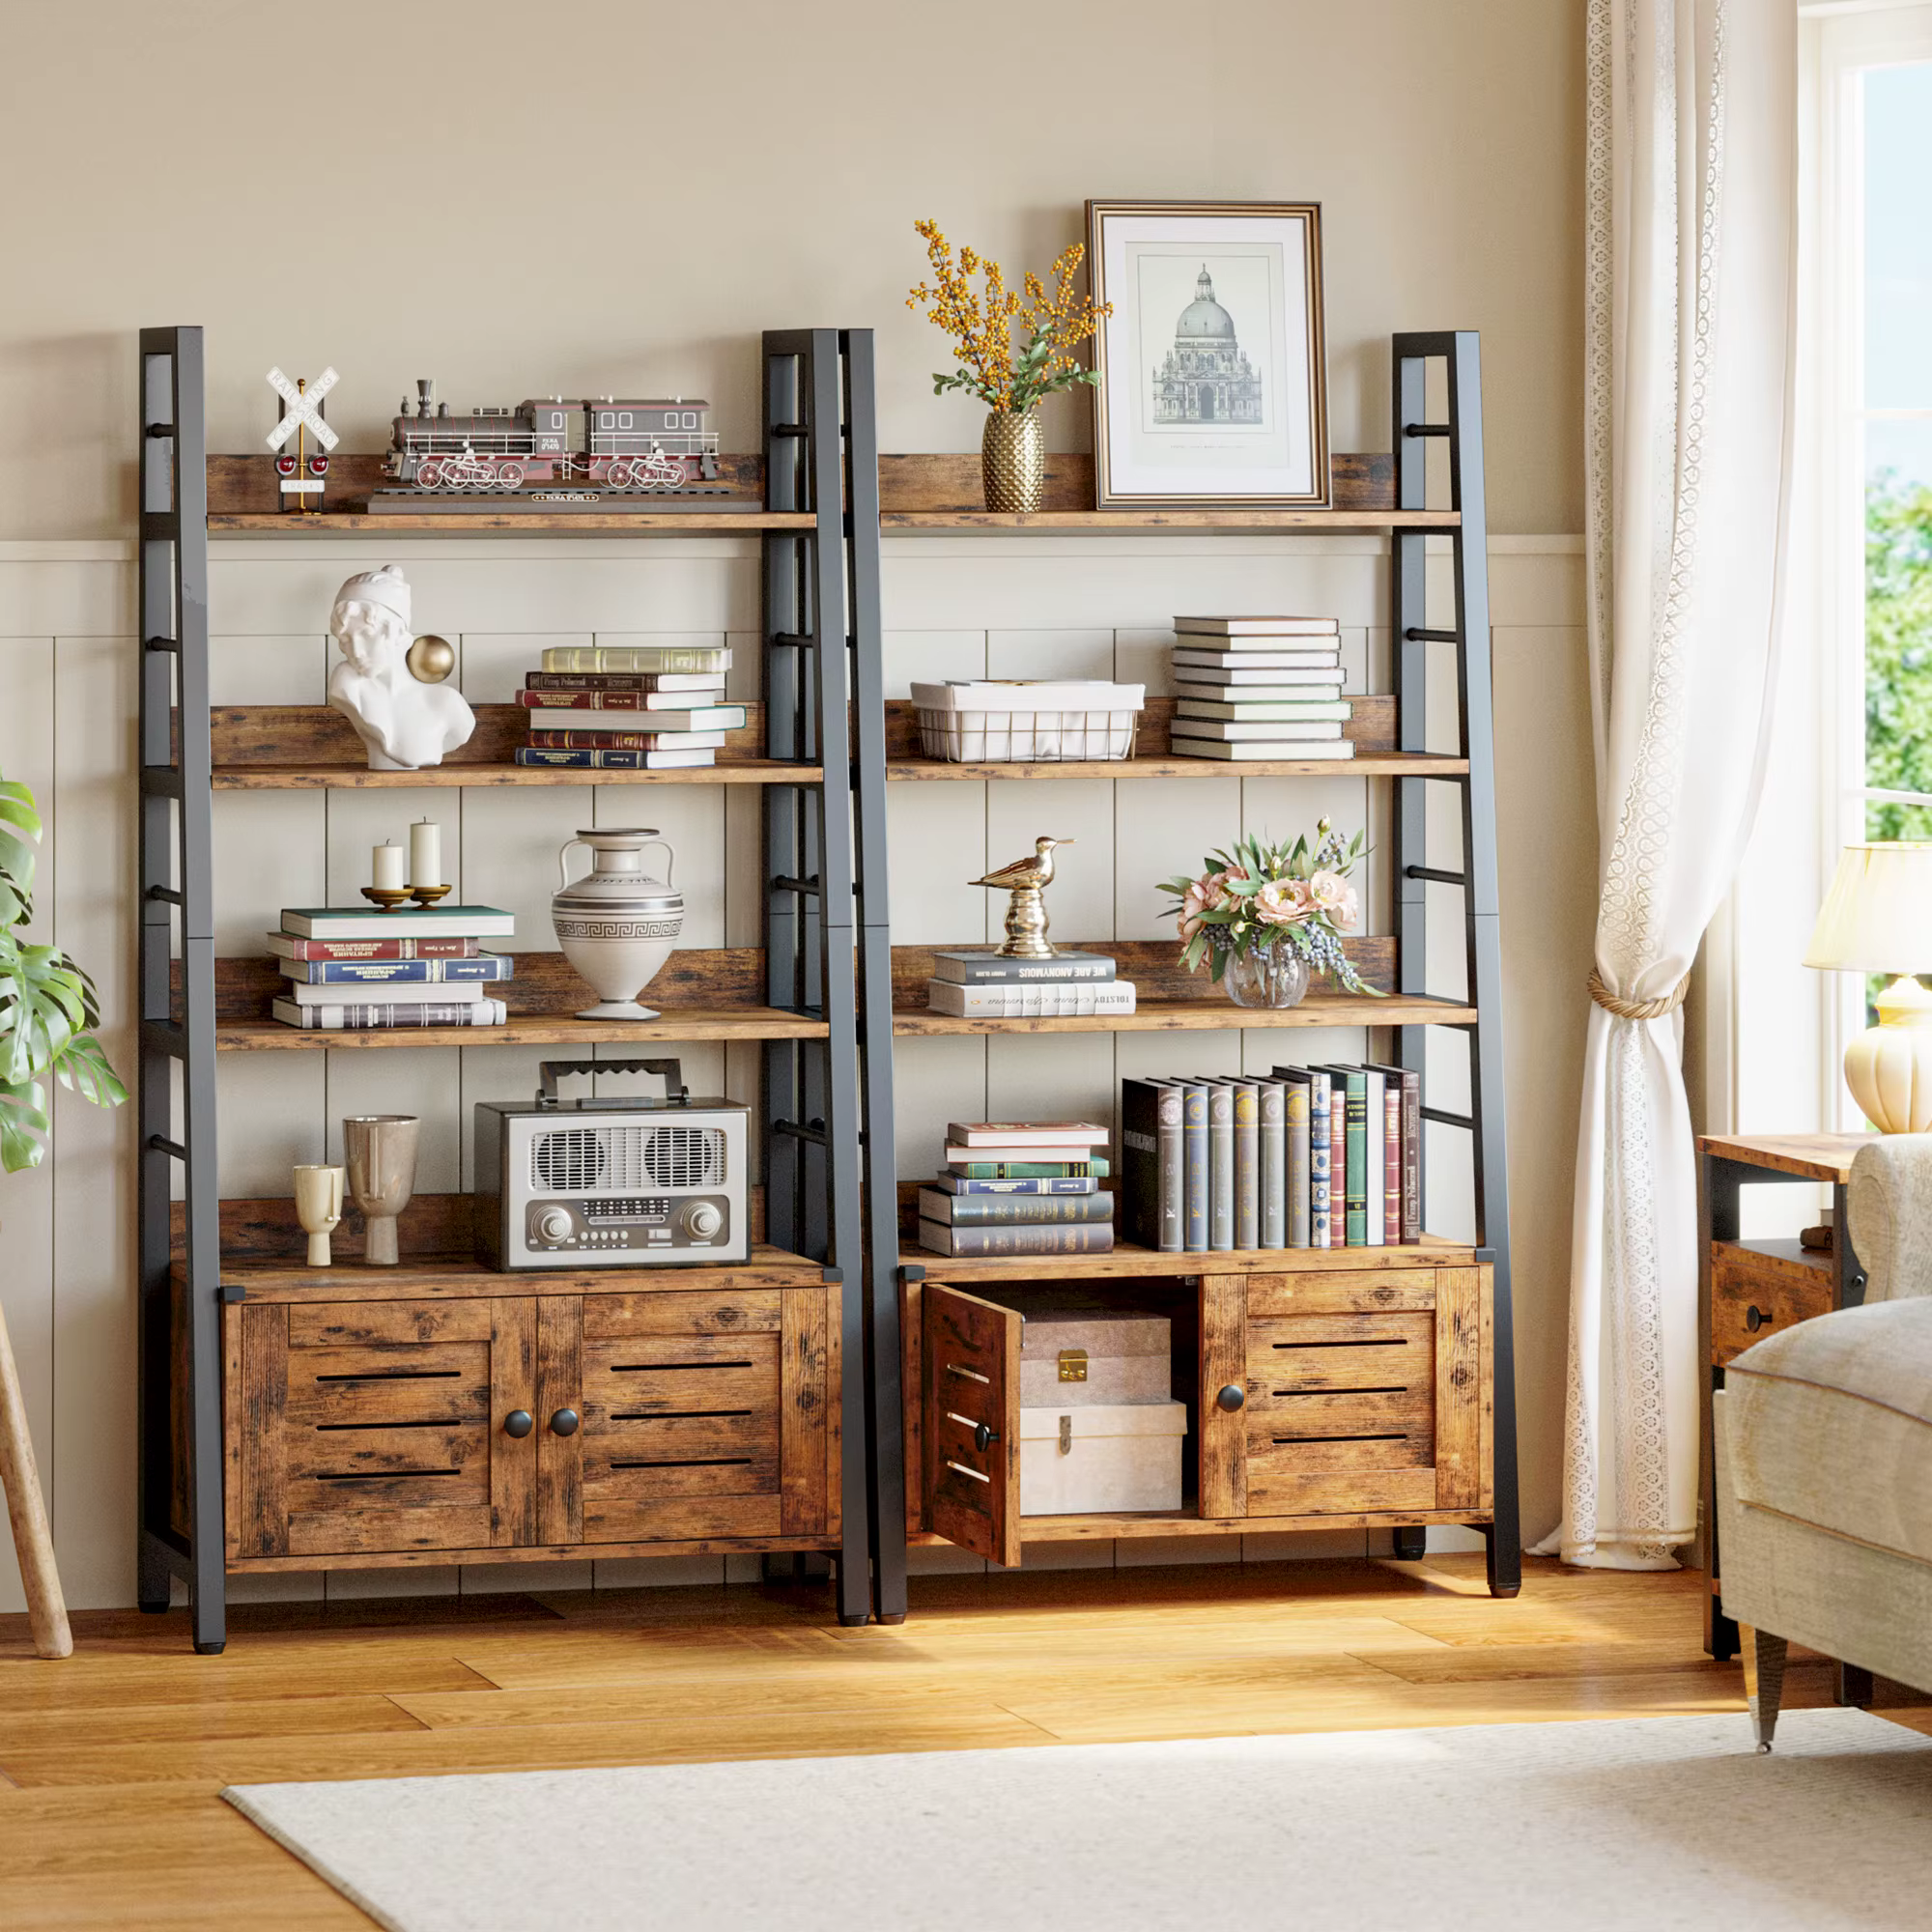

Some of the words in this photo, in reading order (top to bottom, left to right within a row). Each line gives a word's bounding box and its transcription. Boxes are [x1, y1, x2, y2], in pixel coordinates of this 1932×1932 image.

[271, 372, 296, 403] RAIL
[307, 412, 334, 444] ROAD
[273, 375, 332, 443] CROSSING
[1018, 967, 1072, 978] ANONYMOUS
[1074, 966, 1092, 977] ARE
[1093, 966, 1107, 977] WE
[987, 997, 1048, 1007] Karenina
[1052, 997, 1090, 1006] Anna
[1094, 995, 1129, 1005] TOLSTOY
